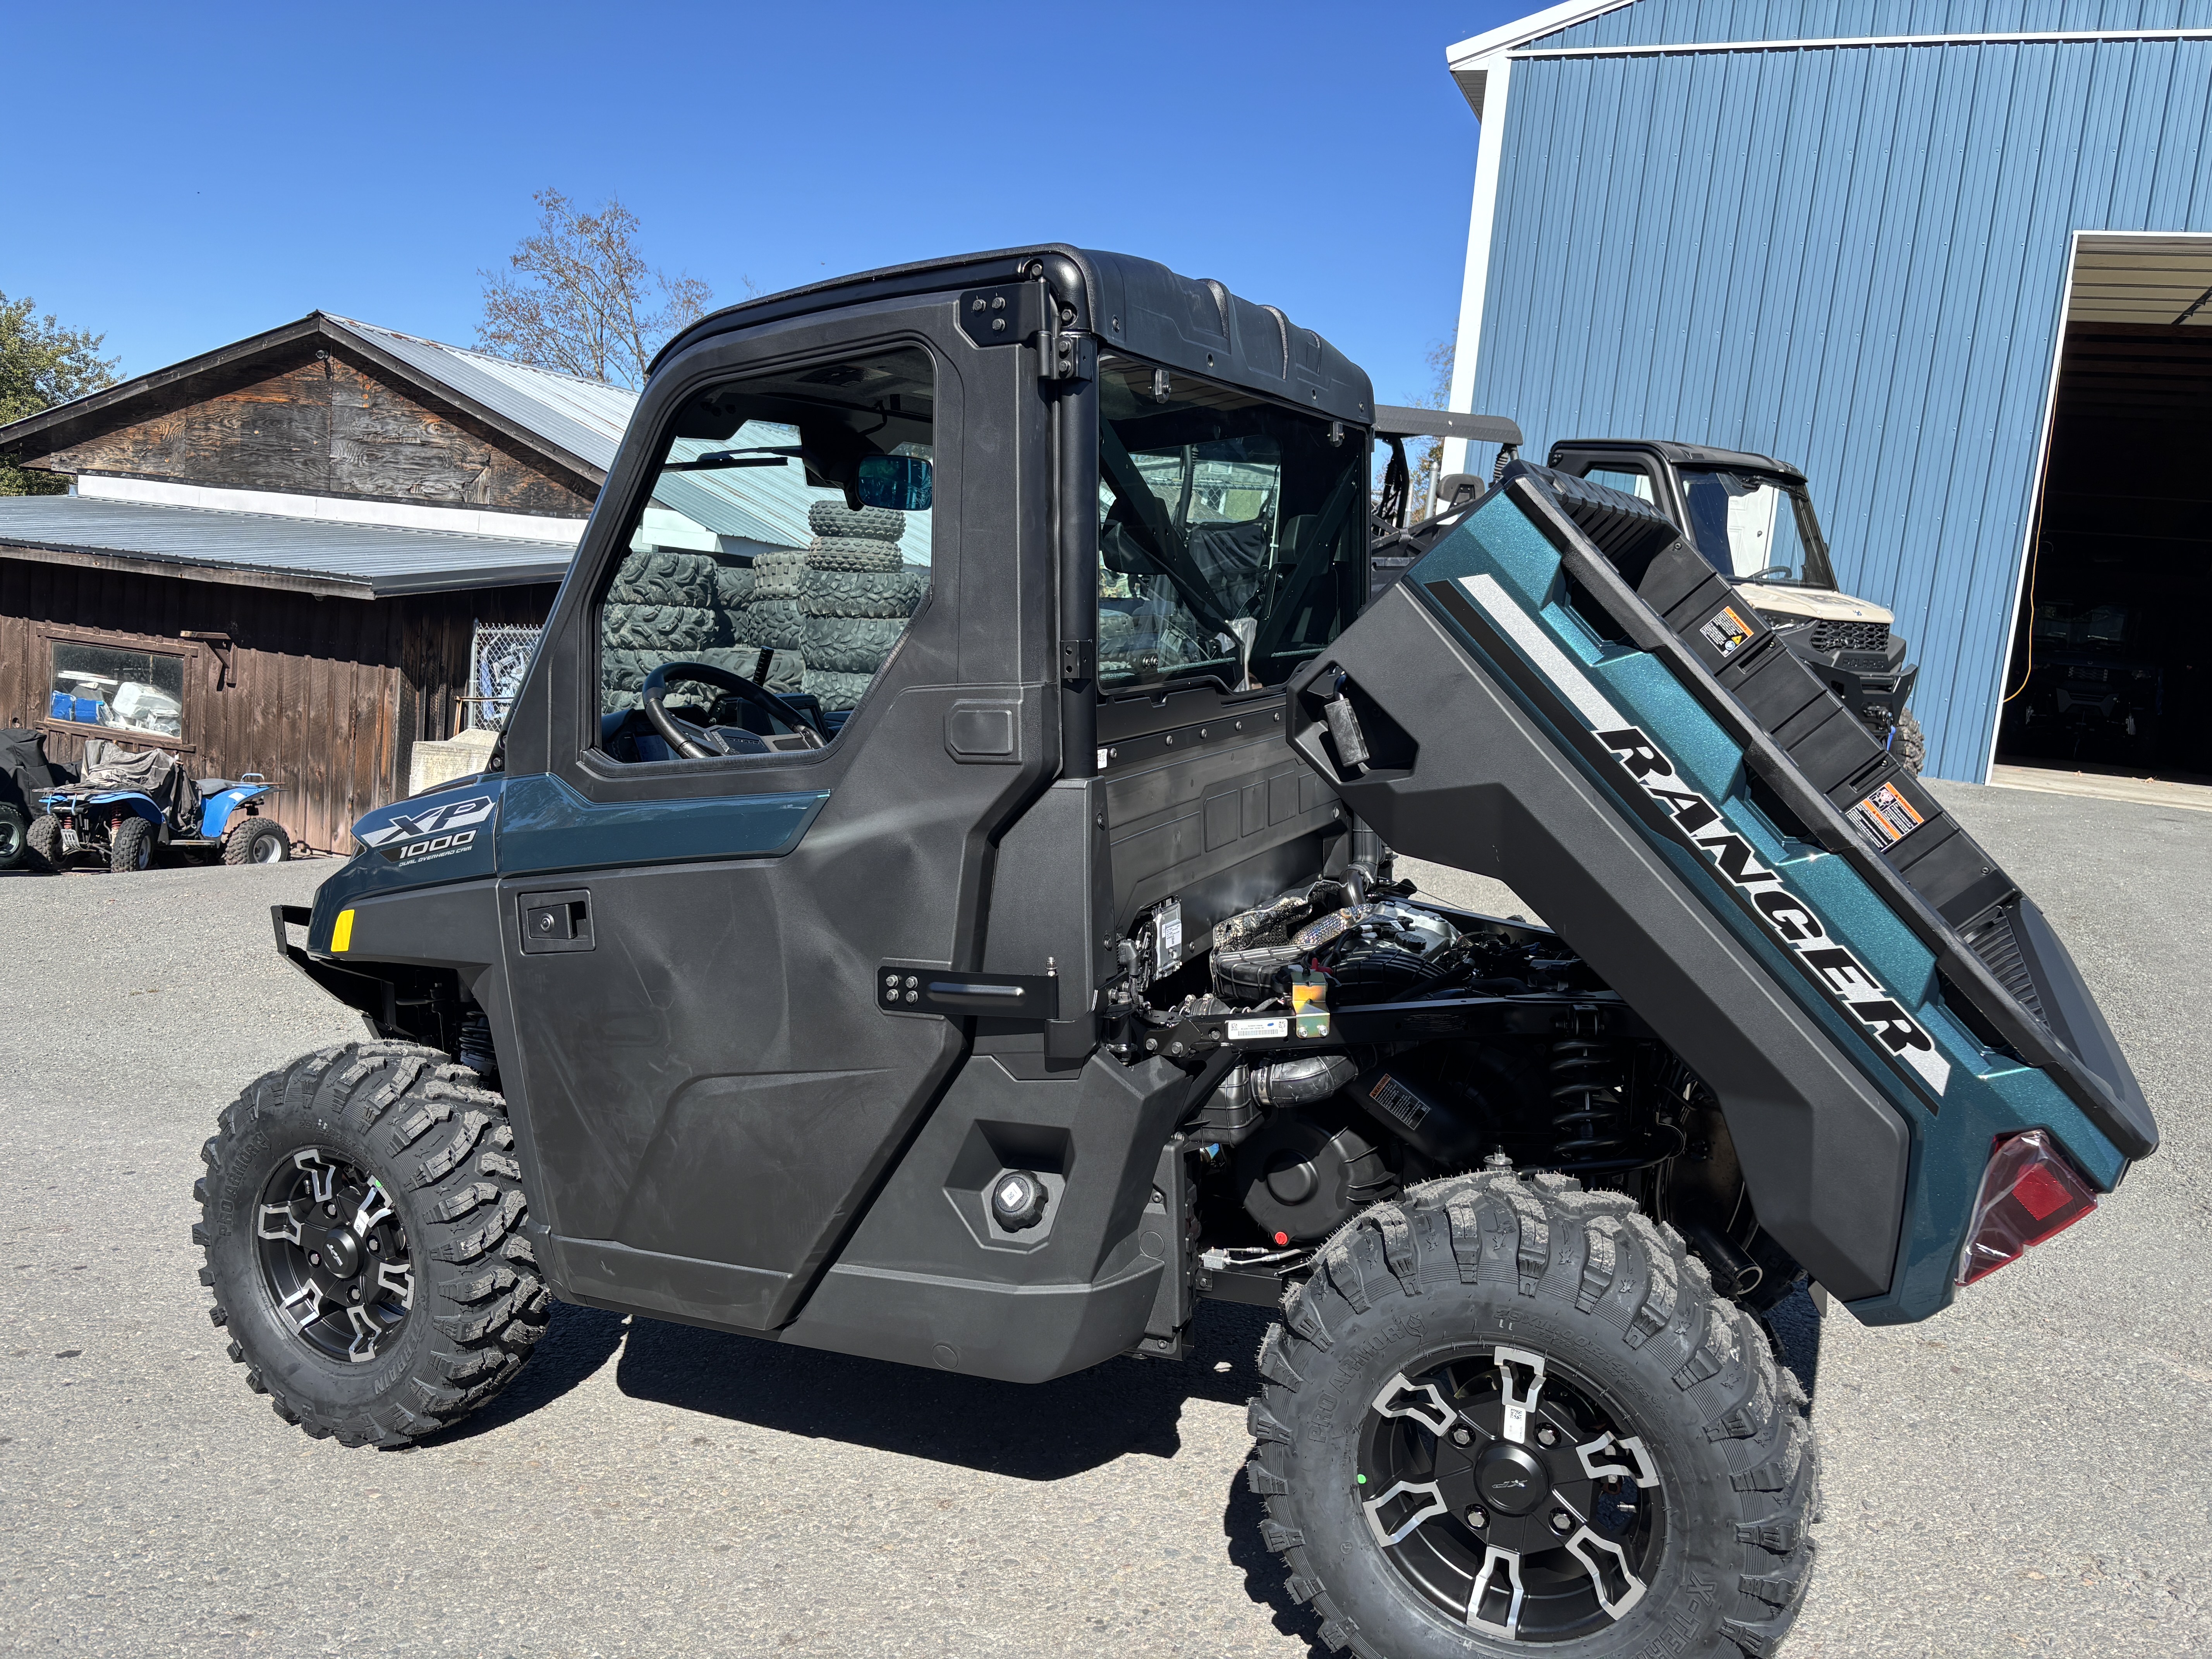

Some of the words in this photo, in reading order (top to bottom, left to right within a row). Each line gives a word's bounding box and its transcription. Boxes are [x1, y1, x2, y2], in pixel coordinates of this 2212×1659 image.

[376, 795, 492, 844] XP
[1875, 812, 1891, 829] WARNING
[1898, 796, 1912, 813] WARNING
[400, 830, 477, 859] 1000
[418, 850, 455, 862] OVERHEAD
[1592, 726, 1936, 1056] RANGER
[225, 1143, 260, 1198] ARMOR
[219, 1199, 234, 1236] PRO
[1308, 1393, 1337, 1443] PRO
[1329, 1324, 1405, 1393] ARMOR
